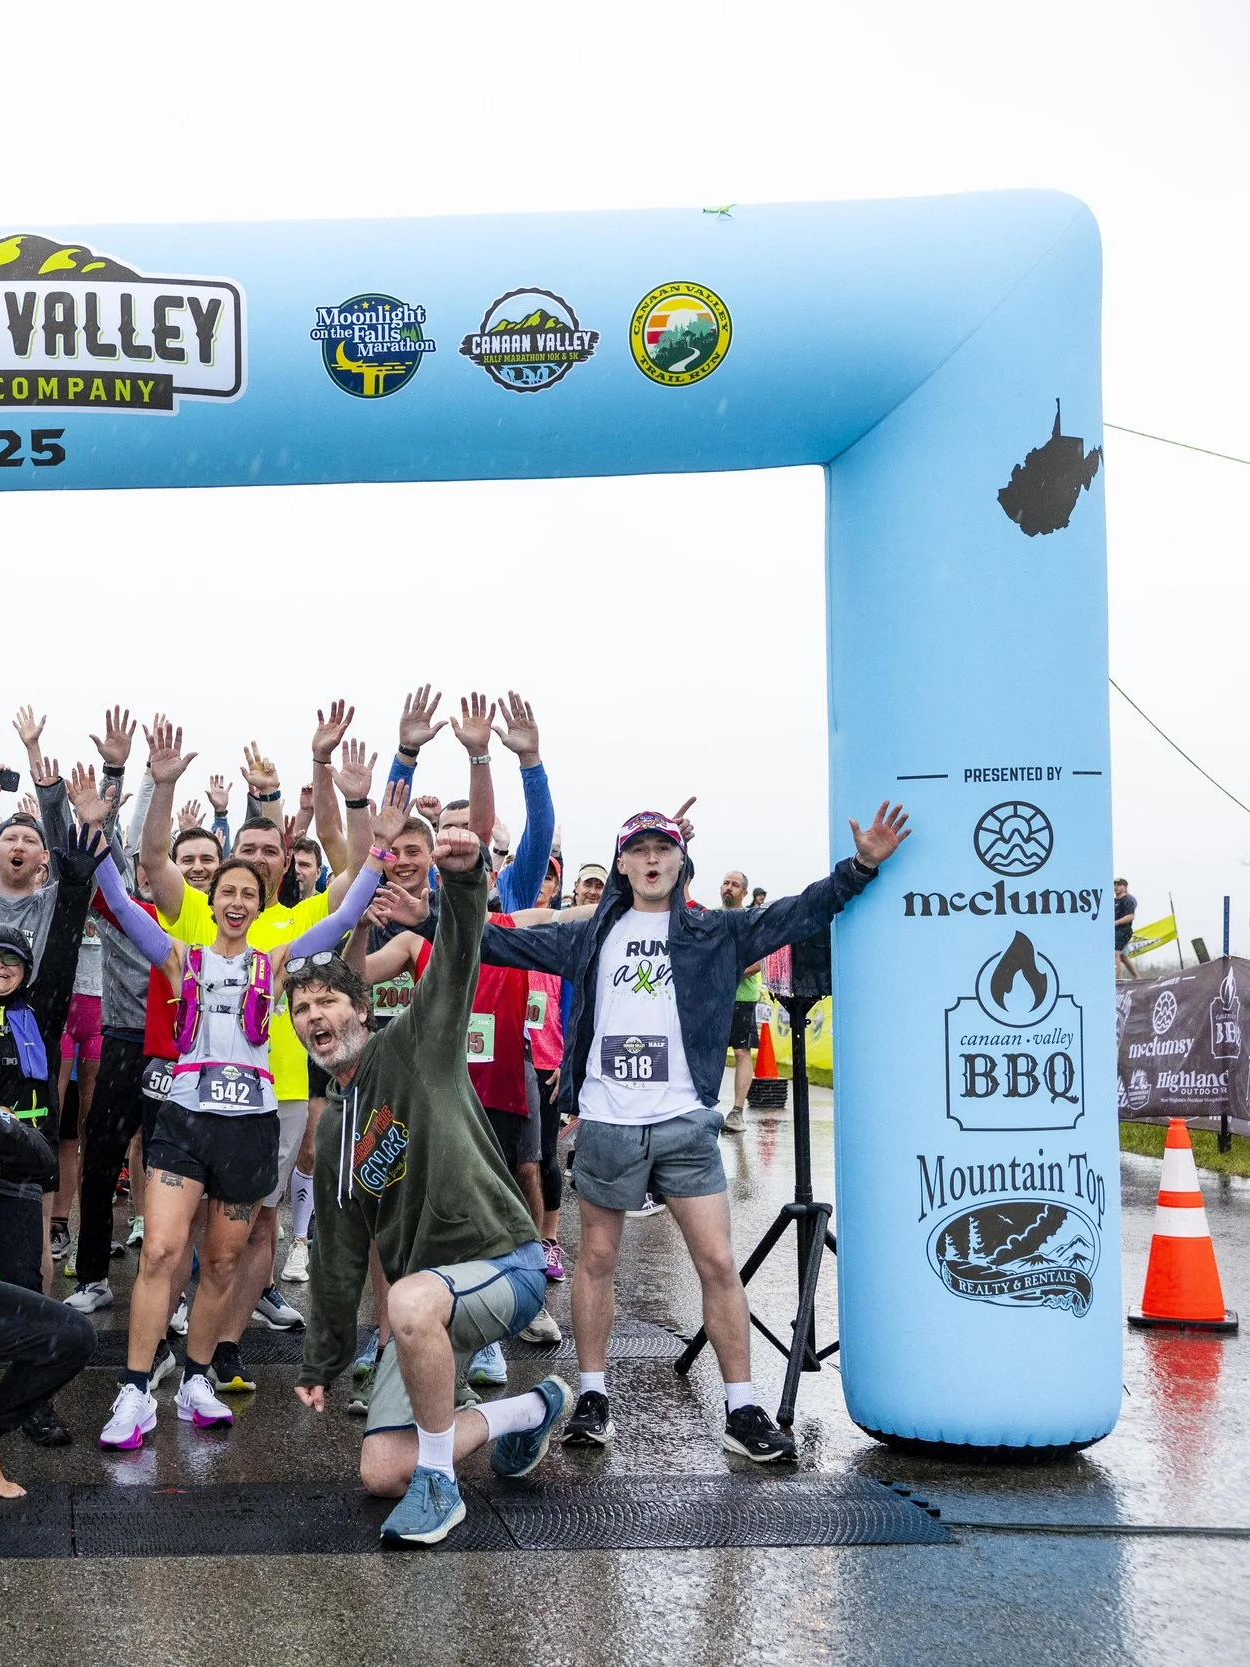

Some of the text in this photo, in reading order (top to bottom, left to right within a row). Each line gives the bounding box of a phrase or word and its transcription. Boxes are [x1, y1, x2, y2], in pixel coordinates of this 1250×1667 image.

[317, 305, 426, 328] Moonlight
[633, 285, 729, 336] CANAAN VALLEY
[4, 291, 223, 364] VALLEY
[311, 324, 401, 343] on the Falls
[357, 338, 435, 357] Marathon
[472, 332, 591, 354] CANAAN VALLEY
[484, 352, 579, 363] HALF MARATHON 10K & 5K
[639, 352, 721, 382] TRAIL RUN
[964, 766, 1063, 783] PRESENTED BY
[902, 879, 1103, 921] mcclumsy
[625, 940, 670, 957] RUN
[960, 1028, 1074, 1050] canaan valley
[1128, 1035, 1194, 1059] mcclumsy
[614, 1055, 653, 1079] 518
[959, 1051, 1080, 1104] BBQ
[149, 1071, 173, 1093] 50
[211, 1080, 250, 1104] 542
[373, 1104, 395, 1135] THE
[916, 1148, 1106, 1231] Mountain Top
[958, 1271, 1077, 1295] REALTY & RENTALS
